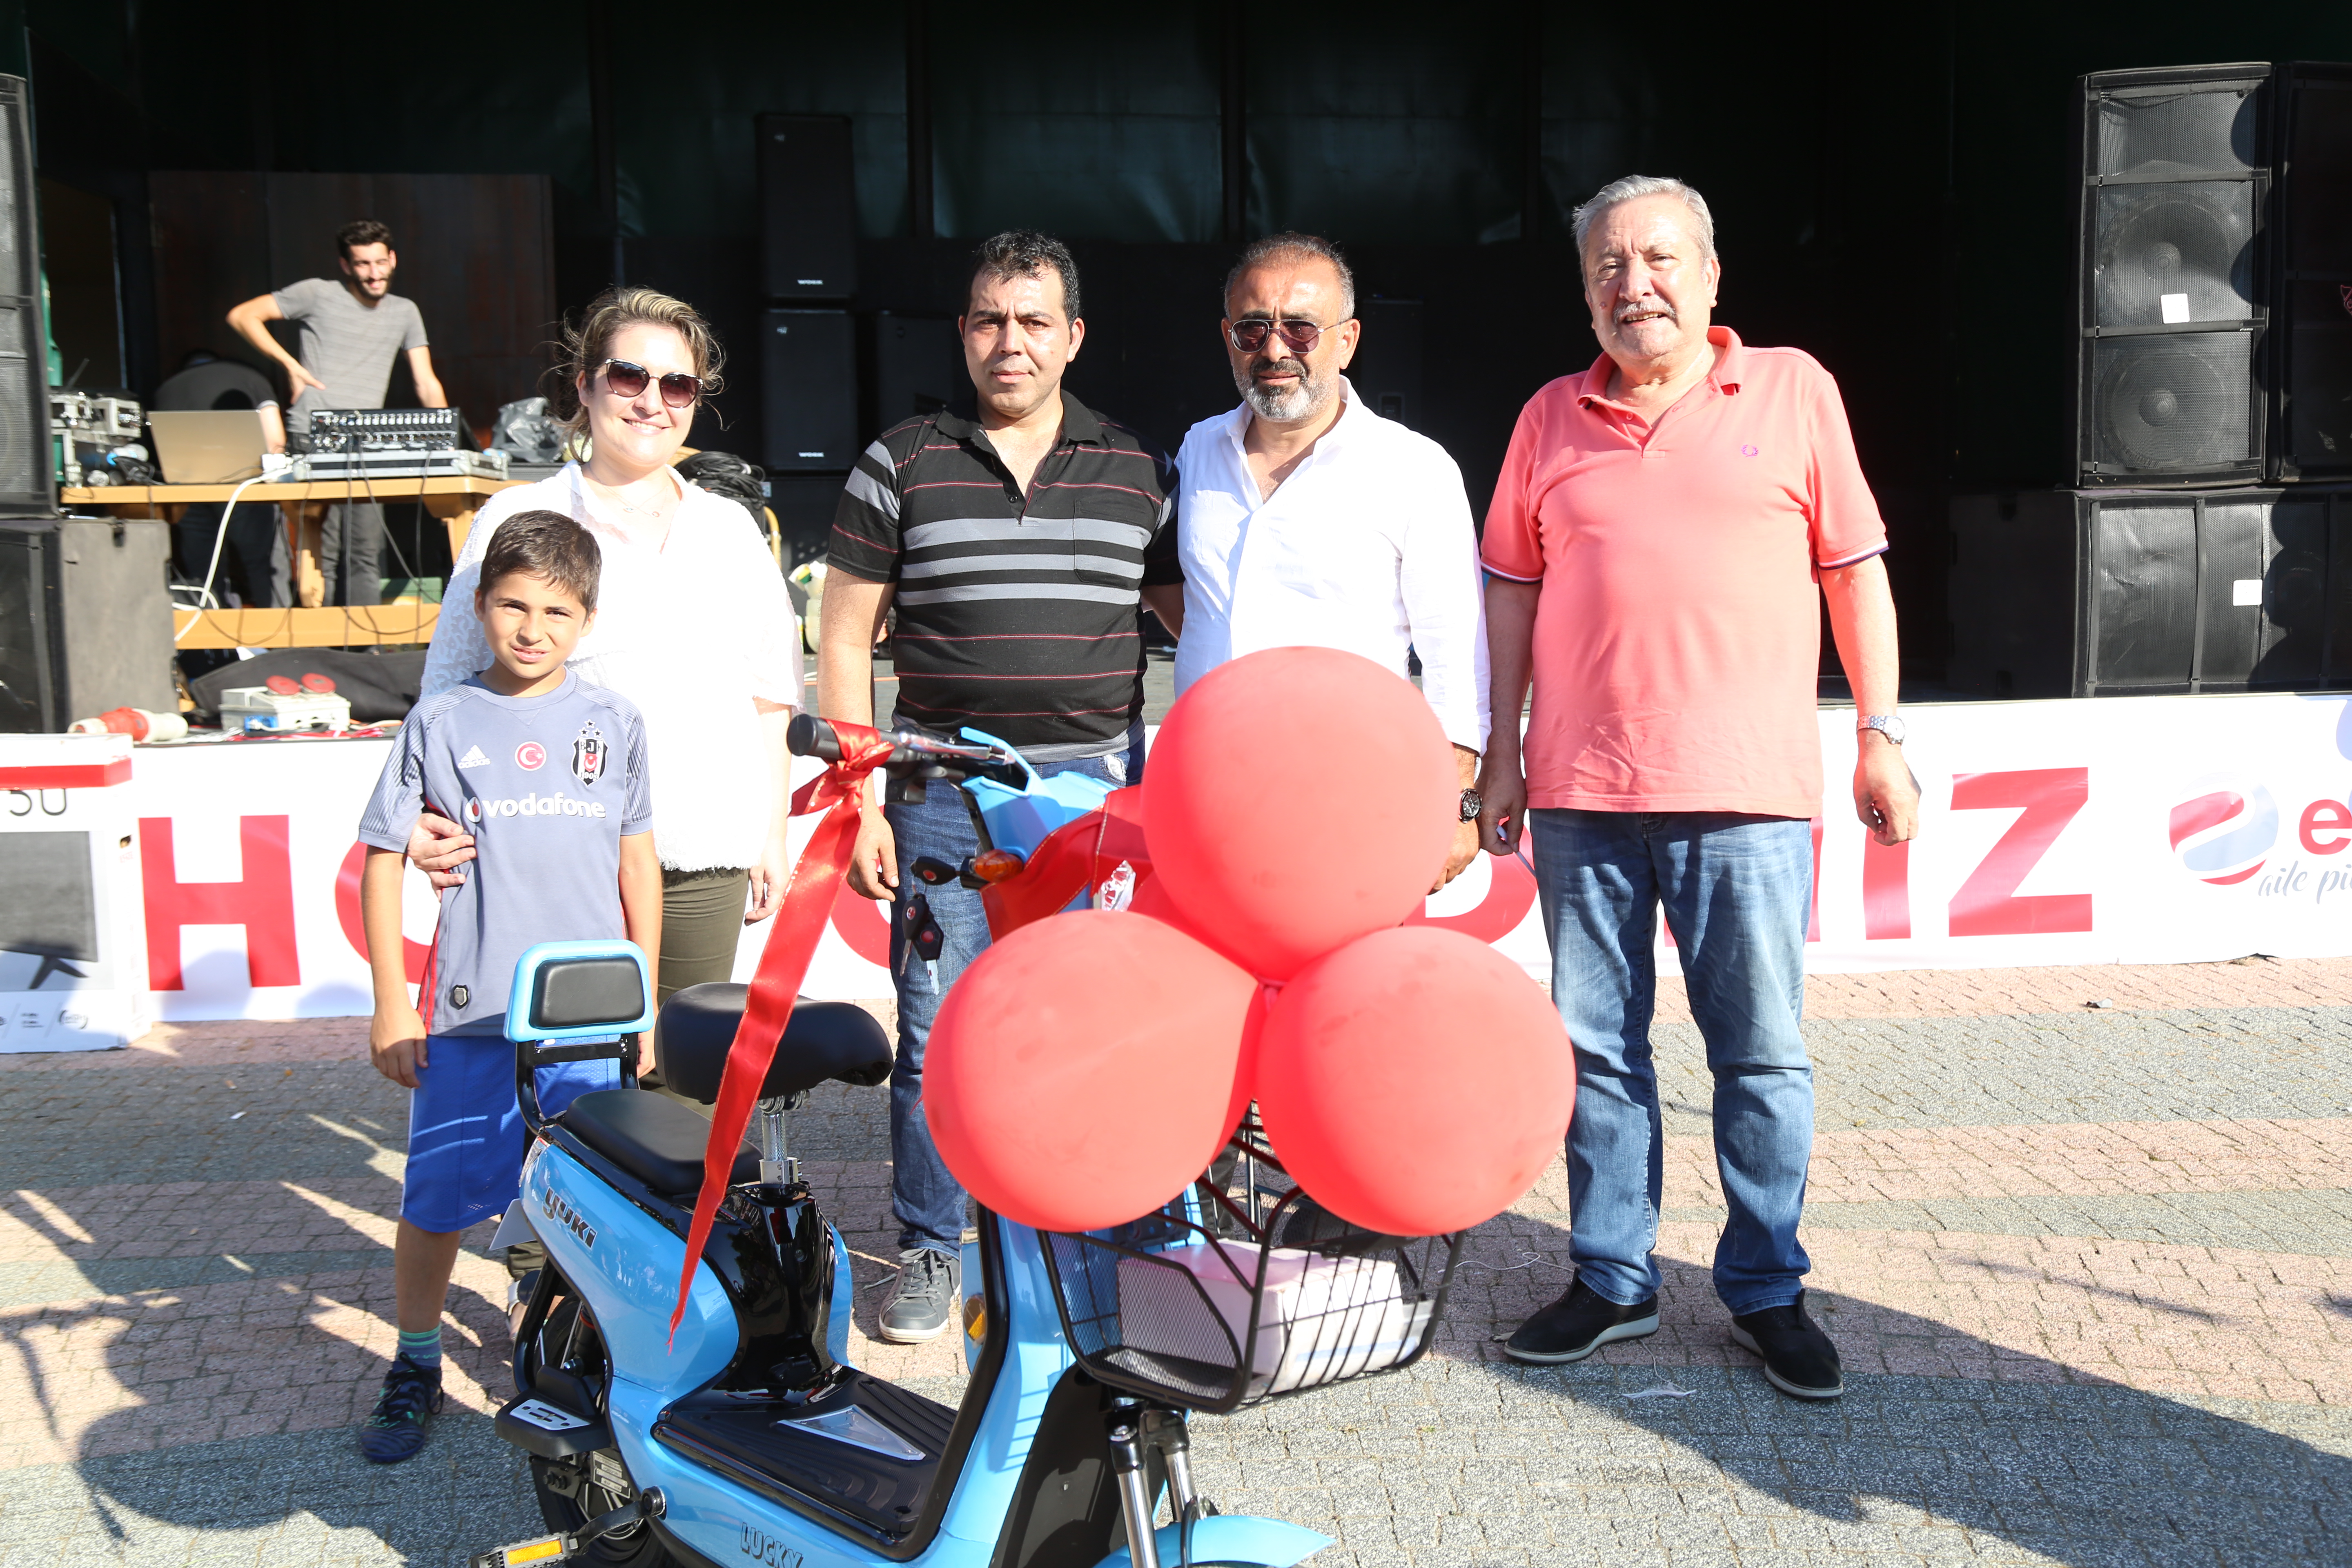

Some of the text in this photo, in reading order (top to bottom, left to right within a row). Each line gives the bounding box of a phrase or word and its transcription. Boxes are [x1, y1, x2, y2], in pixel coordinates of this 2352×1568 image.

[457, 757, 491, 769] adidas
[580, 771, 598, 782] 1903
[482, 791, 607, 818] vodafone
[2258, 860, 2310, 897] aile
[740, 1521, 804, 1568] LUCKY
